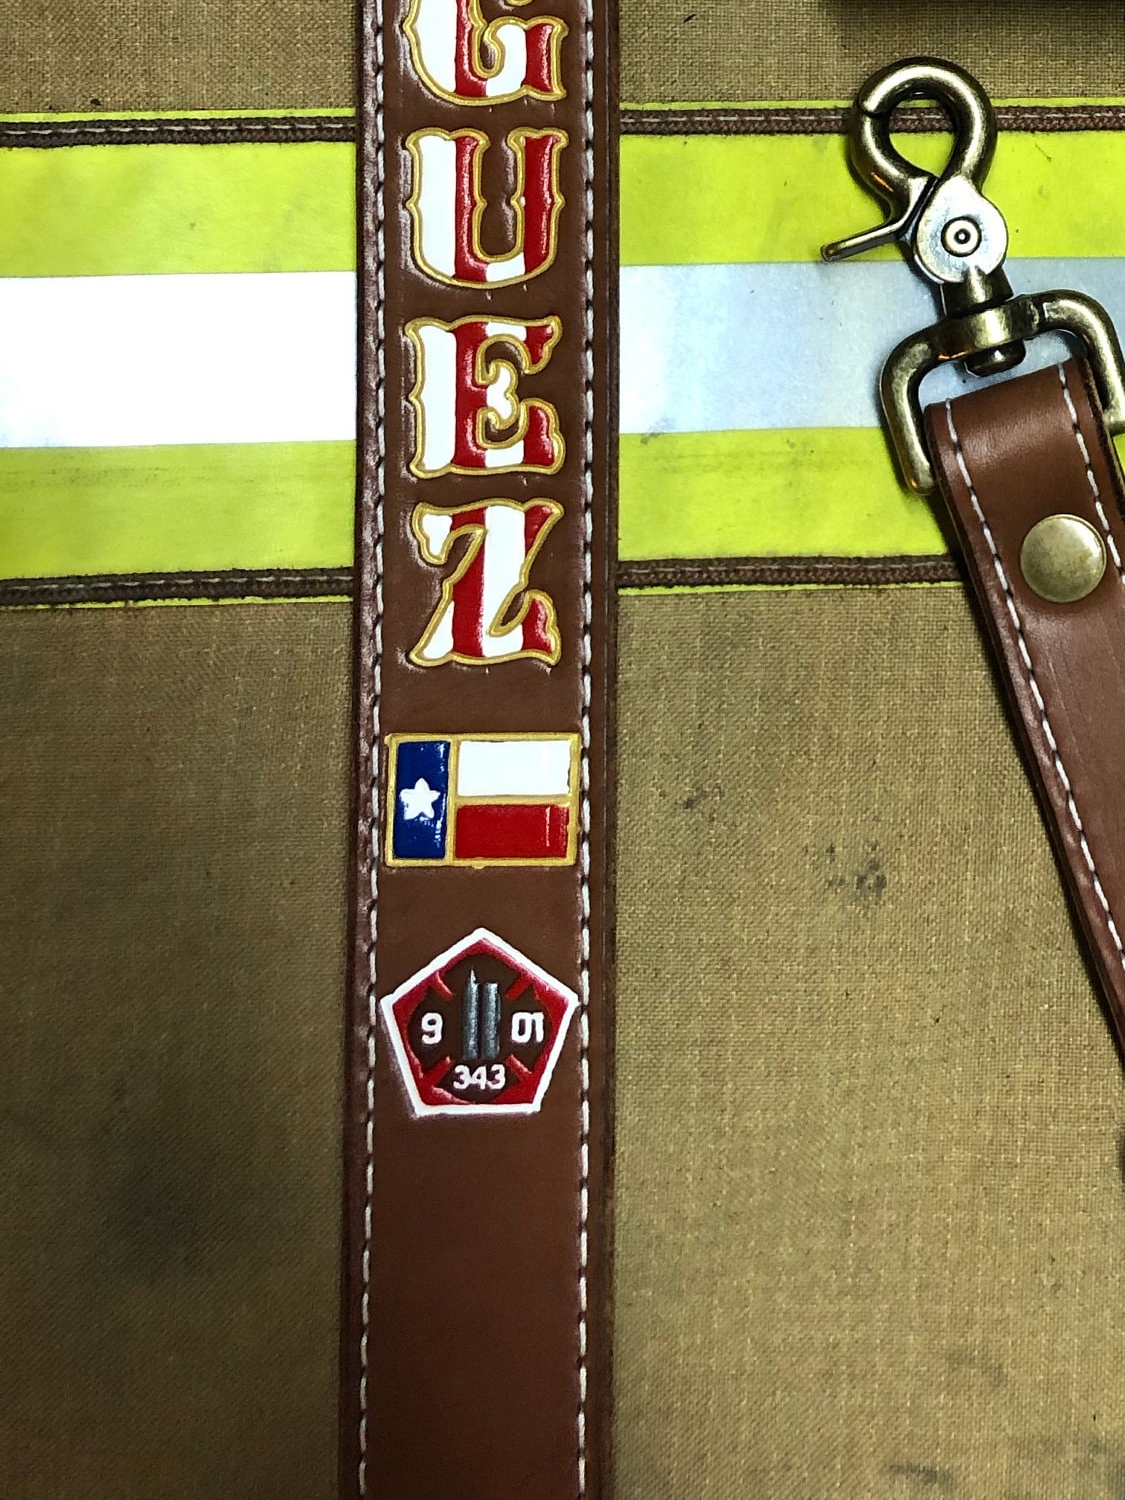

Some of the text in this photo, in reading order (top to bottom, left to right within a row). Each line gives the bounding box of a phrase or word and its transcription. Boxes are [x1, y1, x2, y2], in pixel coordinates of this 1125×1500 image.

[421, 1011, 544, 1045] 9 01
[452, 1064, 506, 1090] 343
